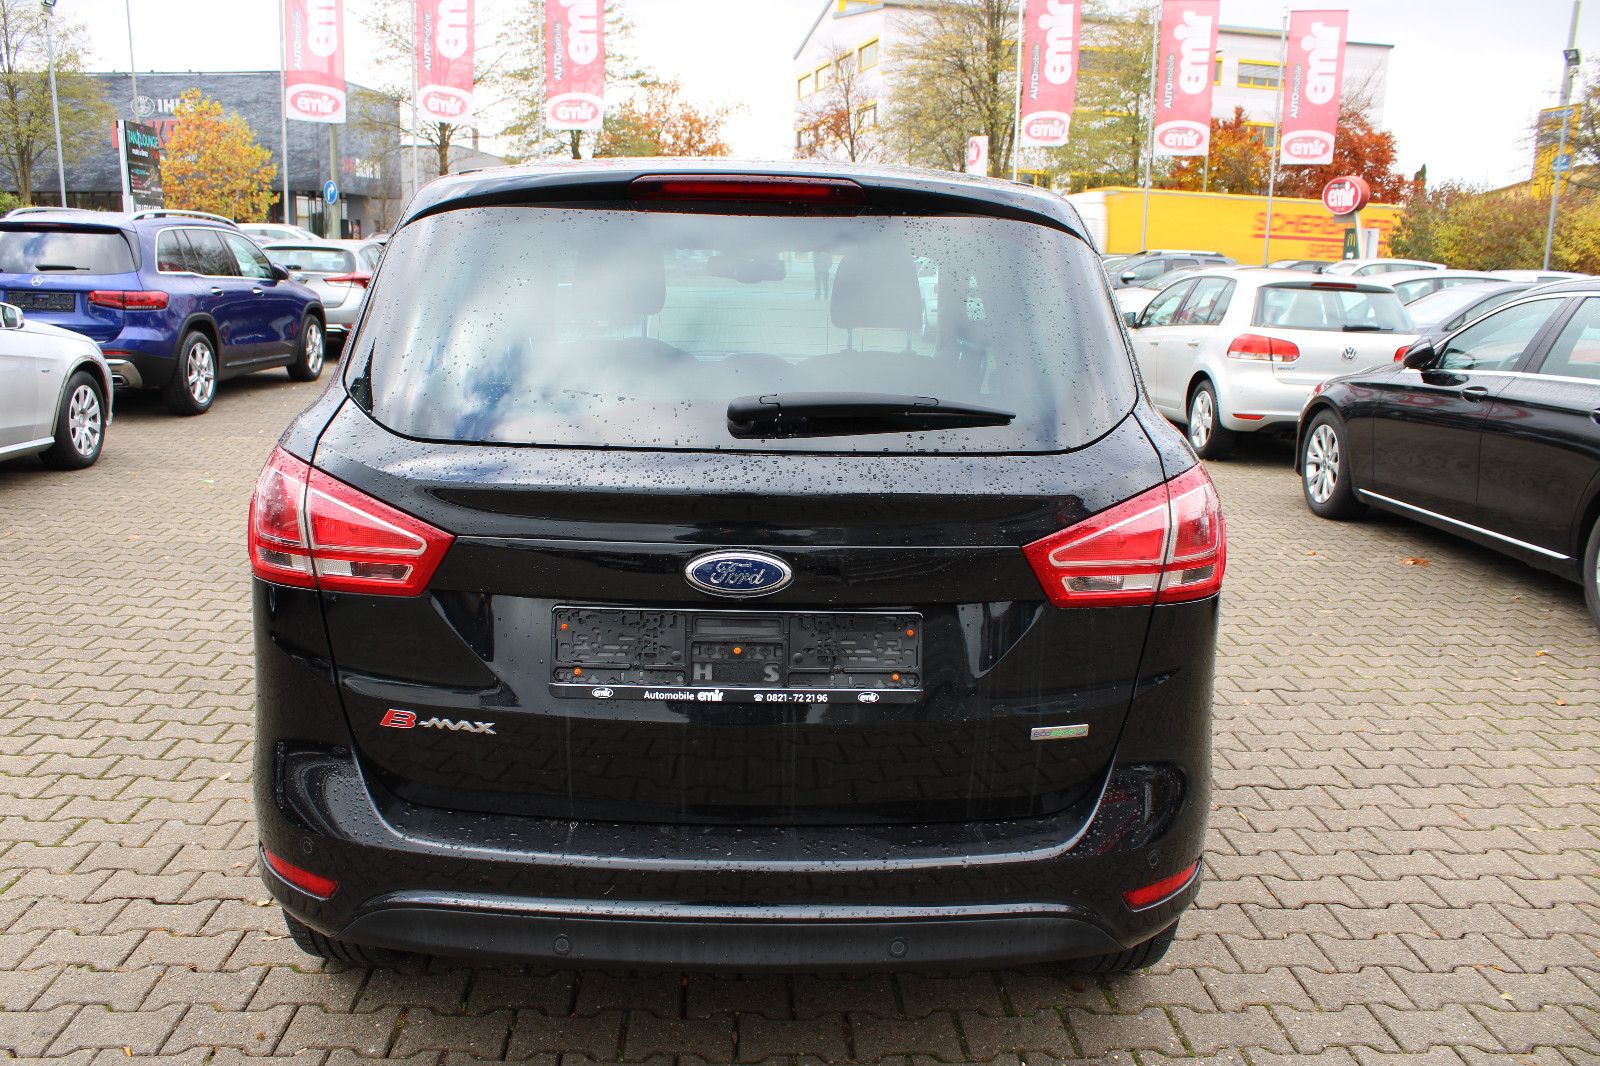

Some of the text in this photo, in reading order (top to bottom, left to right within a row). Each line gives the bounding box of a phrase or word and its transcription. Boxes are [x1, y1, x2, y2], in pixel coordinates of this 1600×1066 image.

[1172, 10, 1213, 95] emir
[1300, 21, 1341, 105] emir
[296, 95, 336, 114] emir
[426, 95, 463, 115] emir
[556, 102, 595, 121] emir
[1029, 120, 1066, 138] emir
[1164, 128, 1200, 147] emir
[1290, 138, 1326, 156] emir
[1327, 181, 1356, 207] emir
[710, 561, 766, 585] Ford
[593, 688, 612, 698] emir
[643, 689, 724, 702] Automobile emir
[379, 708, 497, 735] B-MAX
